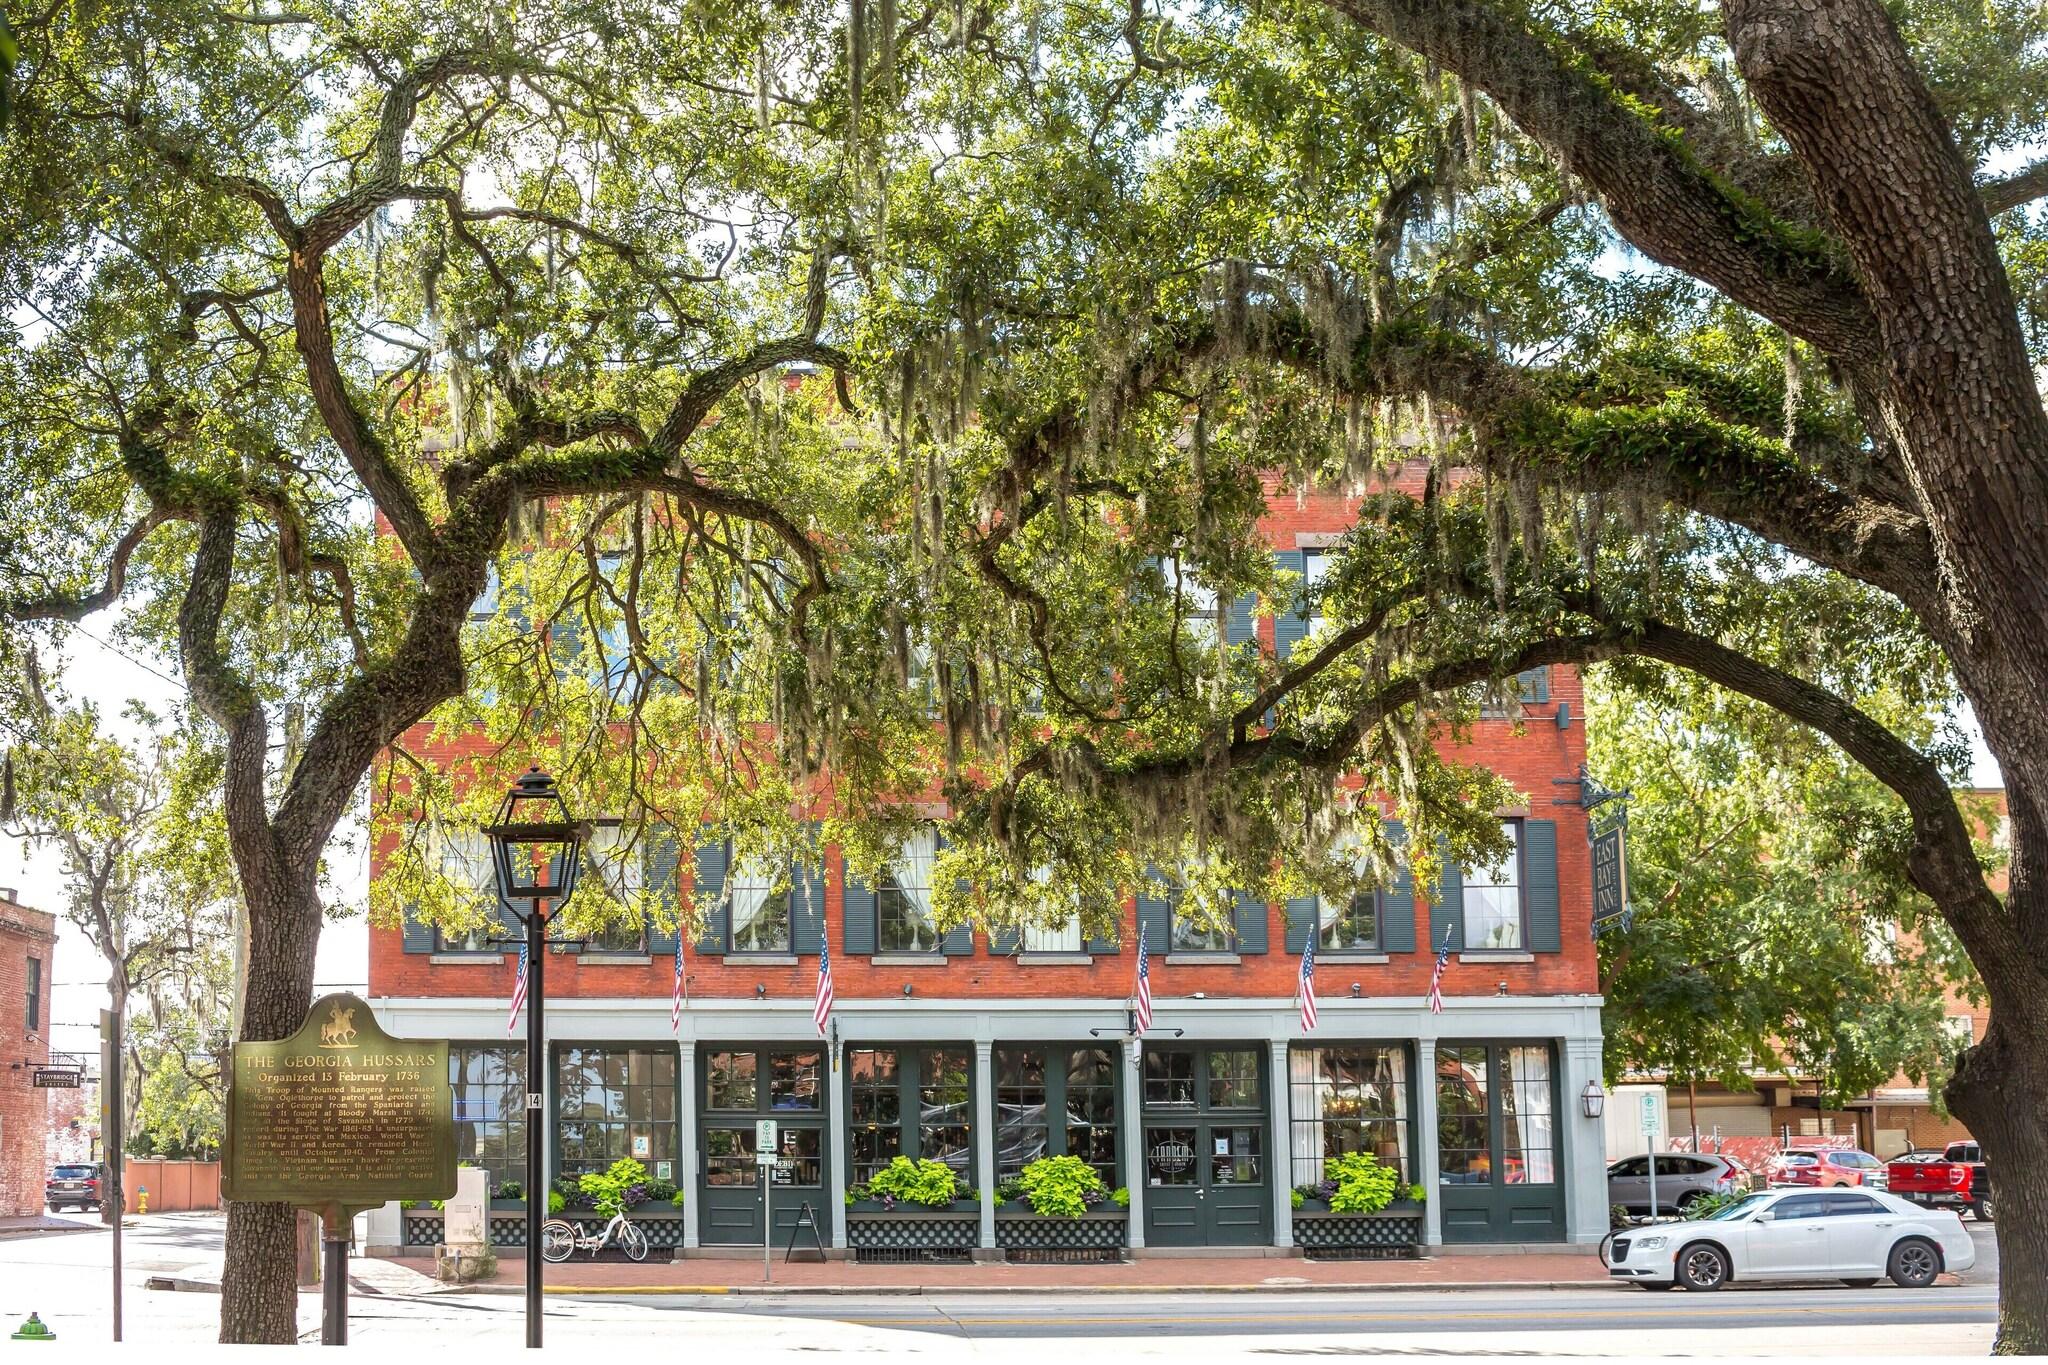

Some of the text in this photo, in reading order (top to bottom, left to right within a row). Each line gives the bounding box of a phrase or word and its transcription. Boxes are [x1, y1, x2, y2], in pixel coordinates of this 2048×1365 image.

[1596, 836, 1616, 866] EAST
[1597, 862, 1612, 888] BAY
[1598, 886, 1615, 912] INN
[243, 1054, 436, 1067] THE GEORGIA HUSSARS
[258, 1072, 420, 1083] Organized 13 February 1736
[530, 1095, 539, 1107] 14
[1156, 1146, 1189, 1162] TANDEM
